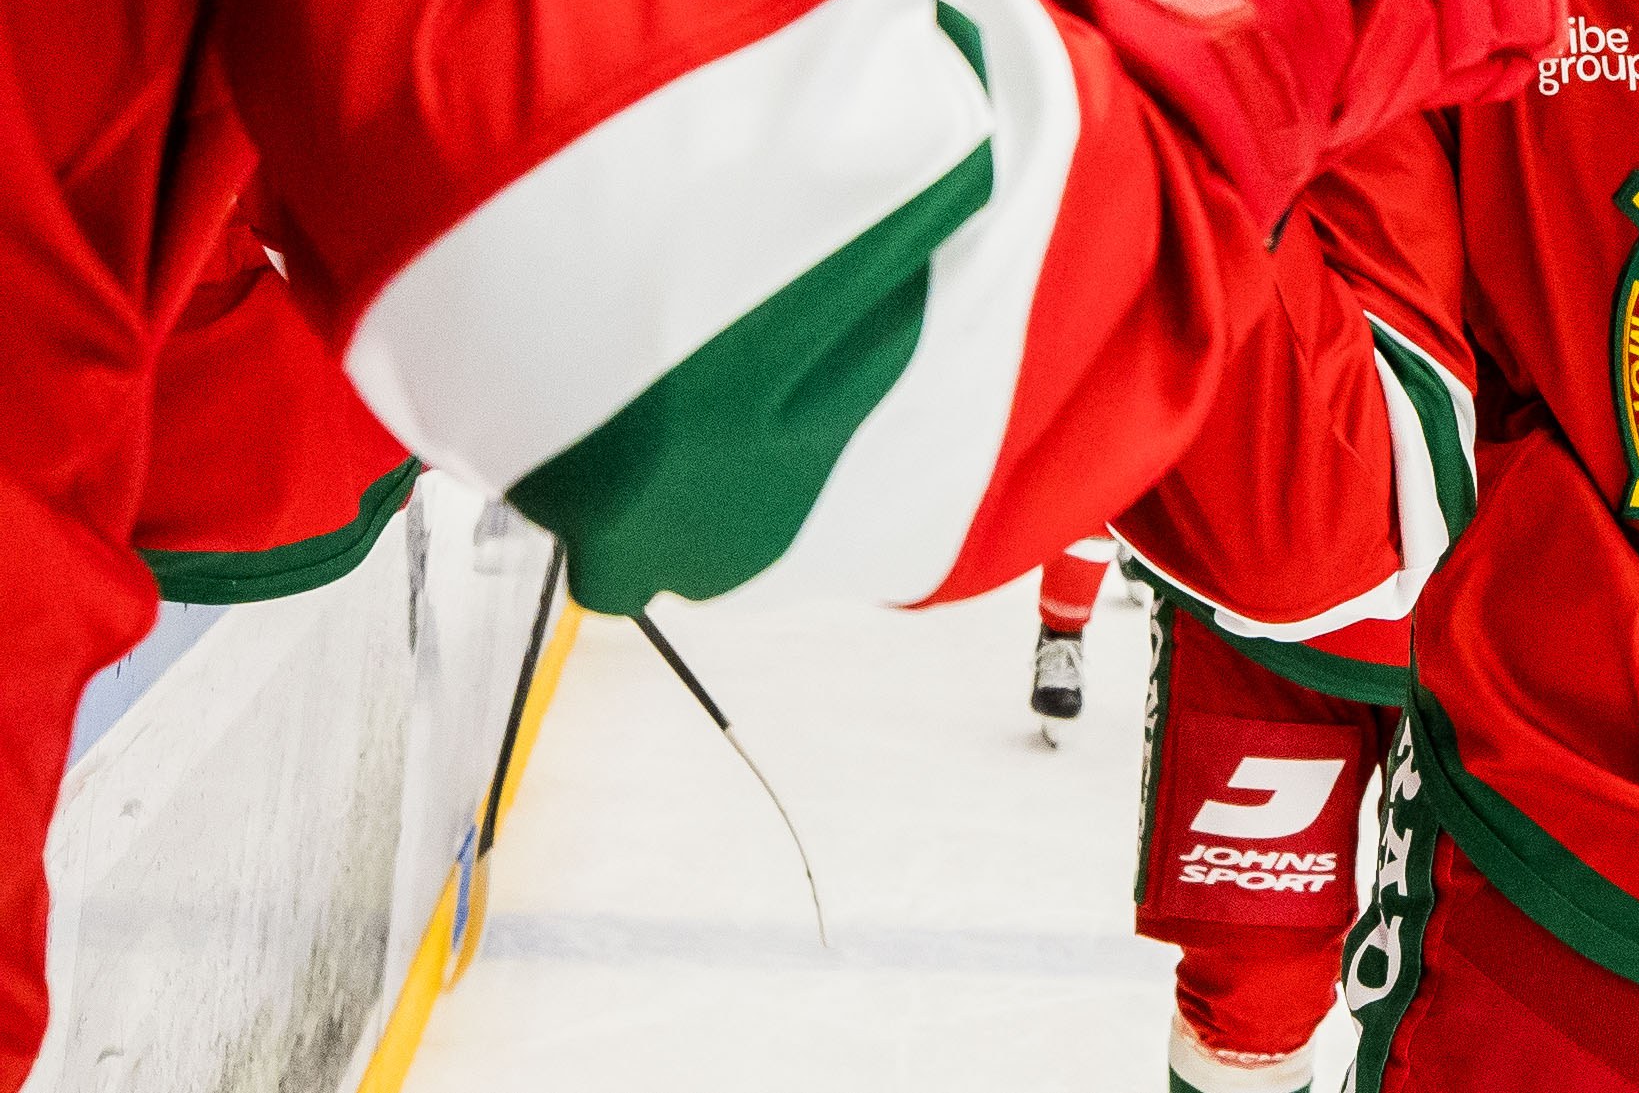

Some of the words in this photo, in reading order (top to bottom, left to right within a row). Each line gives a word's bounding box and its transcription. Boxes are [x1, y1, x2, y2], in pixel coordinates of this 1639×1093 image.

[1567, 15, 1629, 54] ibe
[1179, 843, 1337, 872] JOHNS
[1178, 865, 1337, 893] SPORT
